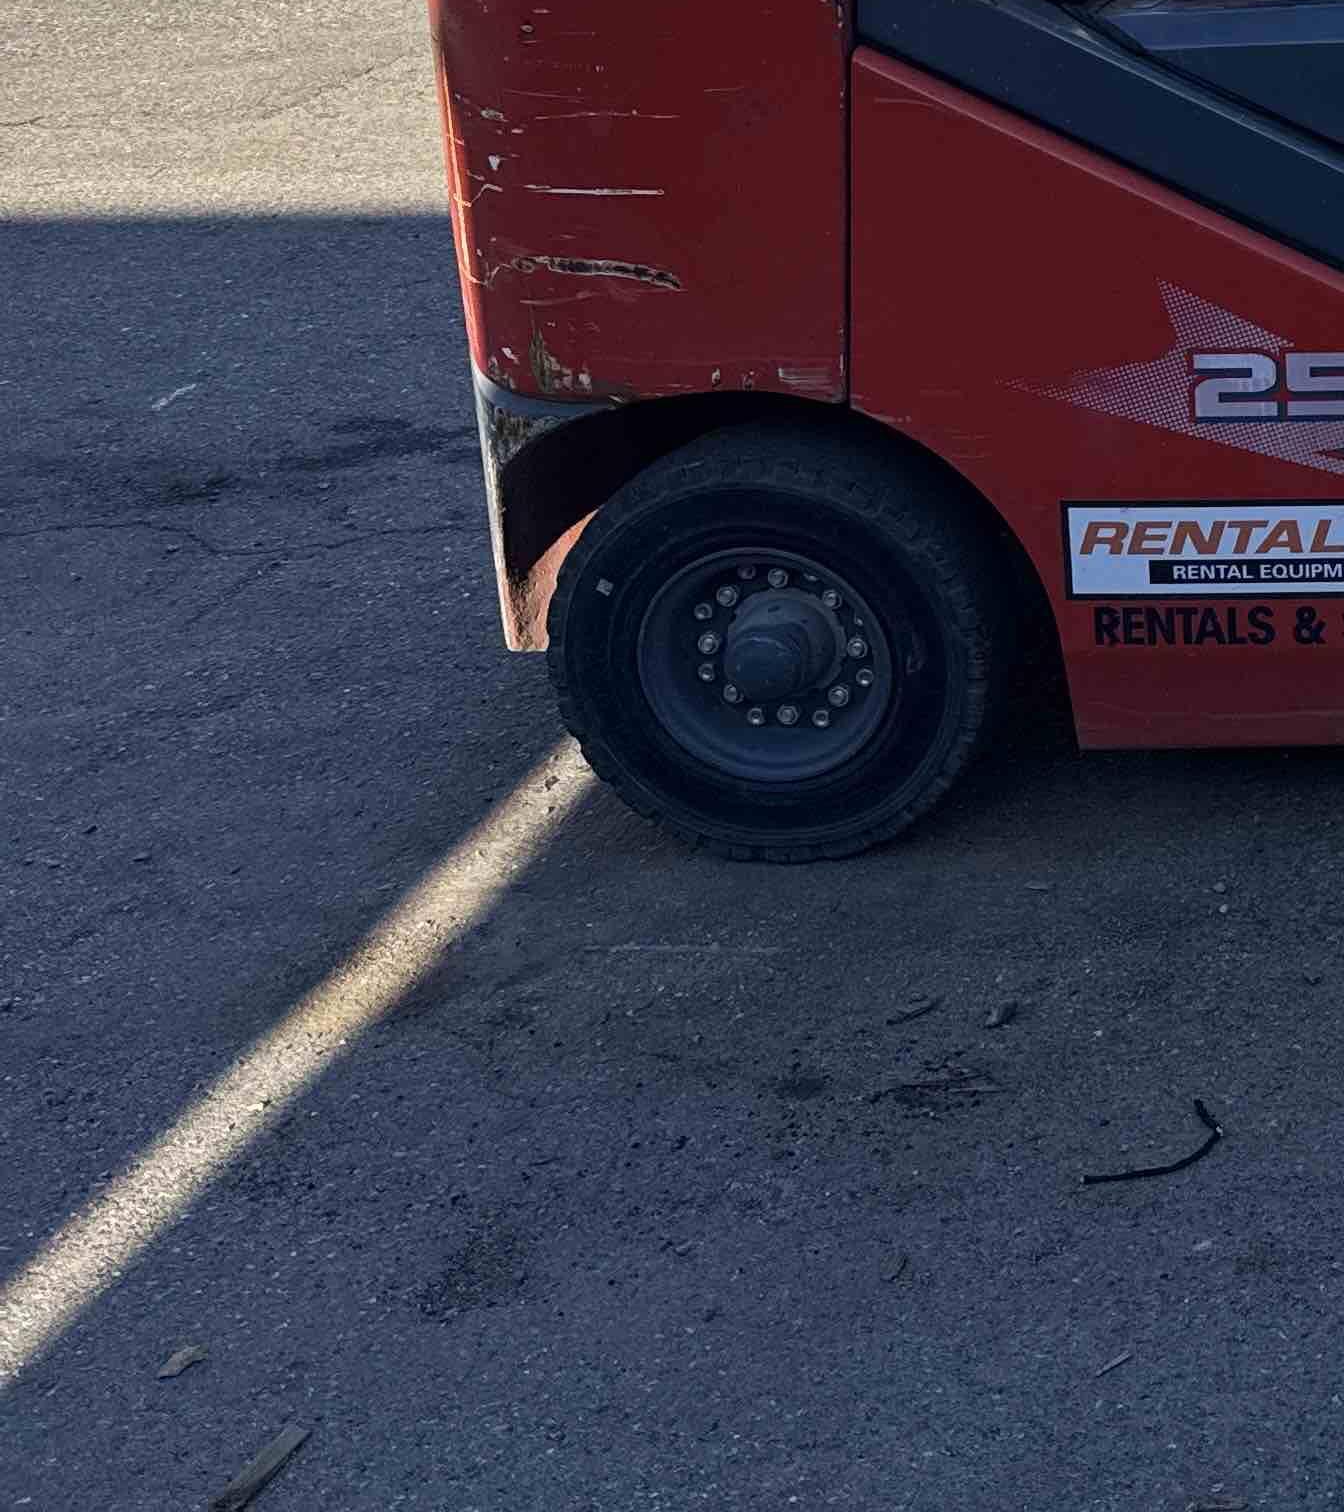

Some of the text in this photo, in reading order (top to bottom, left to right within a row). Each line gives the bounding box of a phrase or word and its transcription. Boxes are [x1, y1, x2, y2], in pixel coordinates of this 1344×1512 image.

[1172, 564, 1254, 581] RENTAL
[1093, 605, 1276, 647] RENTALS
[1295, 605, 1327, 646] &
